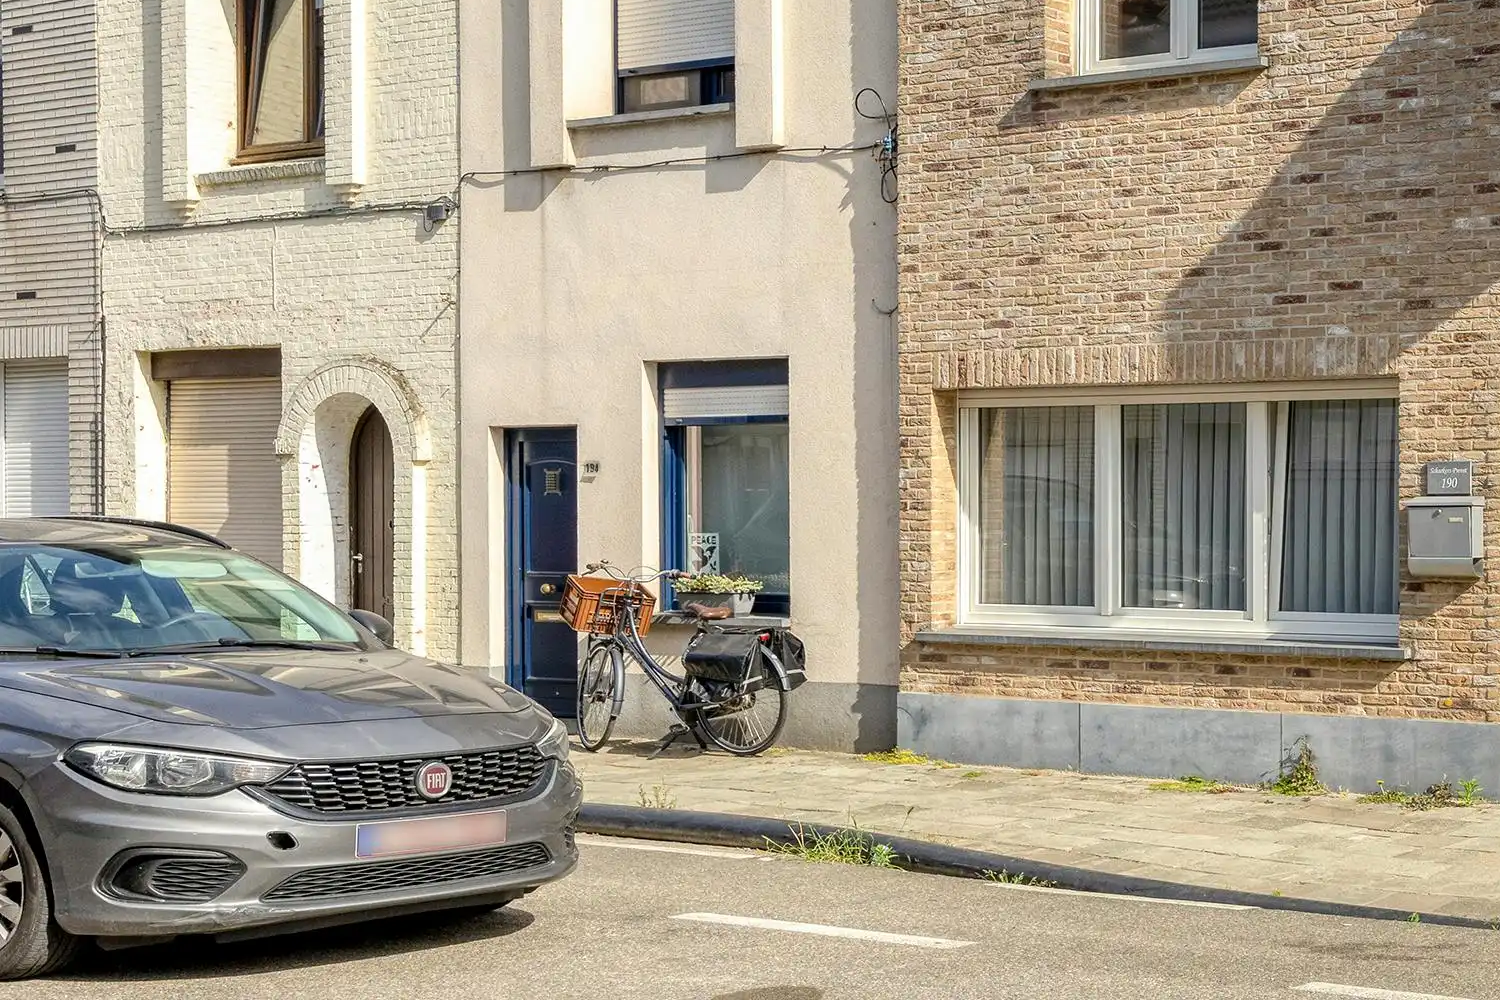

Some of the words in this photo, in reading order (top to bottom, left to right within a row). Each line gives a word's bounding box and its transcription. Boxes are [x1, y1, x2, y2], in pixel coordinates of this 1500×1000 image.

[1442, 477, 1458, 489] 190
[691, 535, 717, 545] PEACE
[427, 772, 446, 789] FIAT
